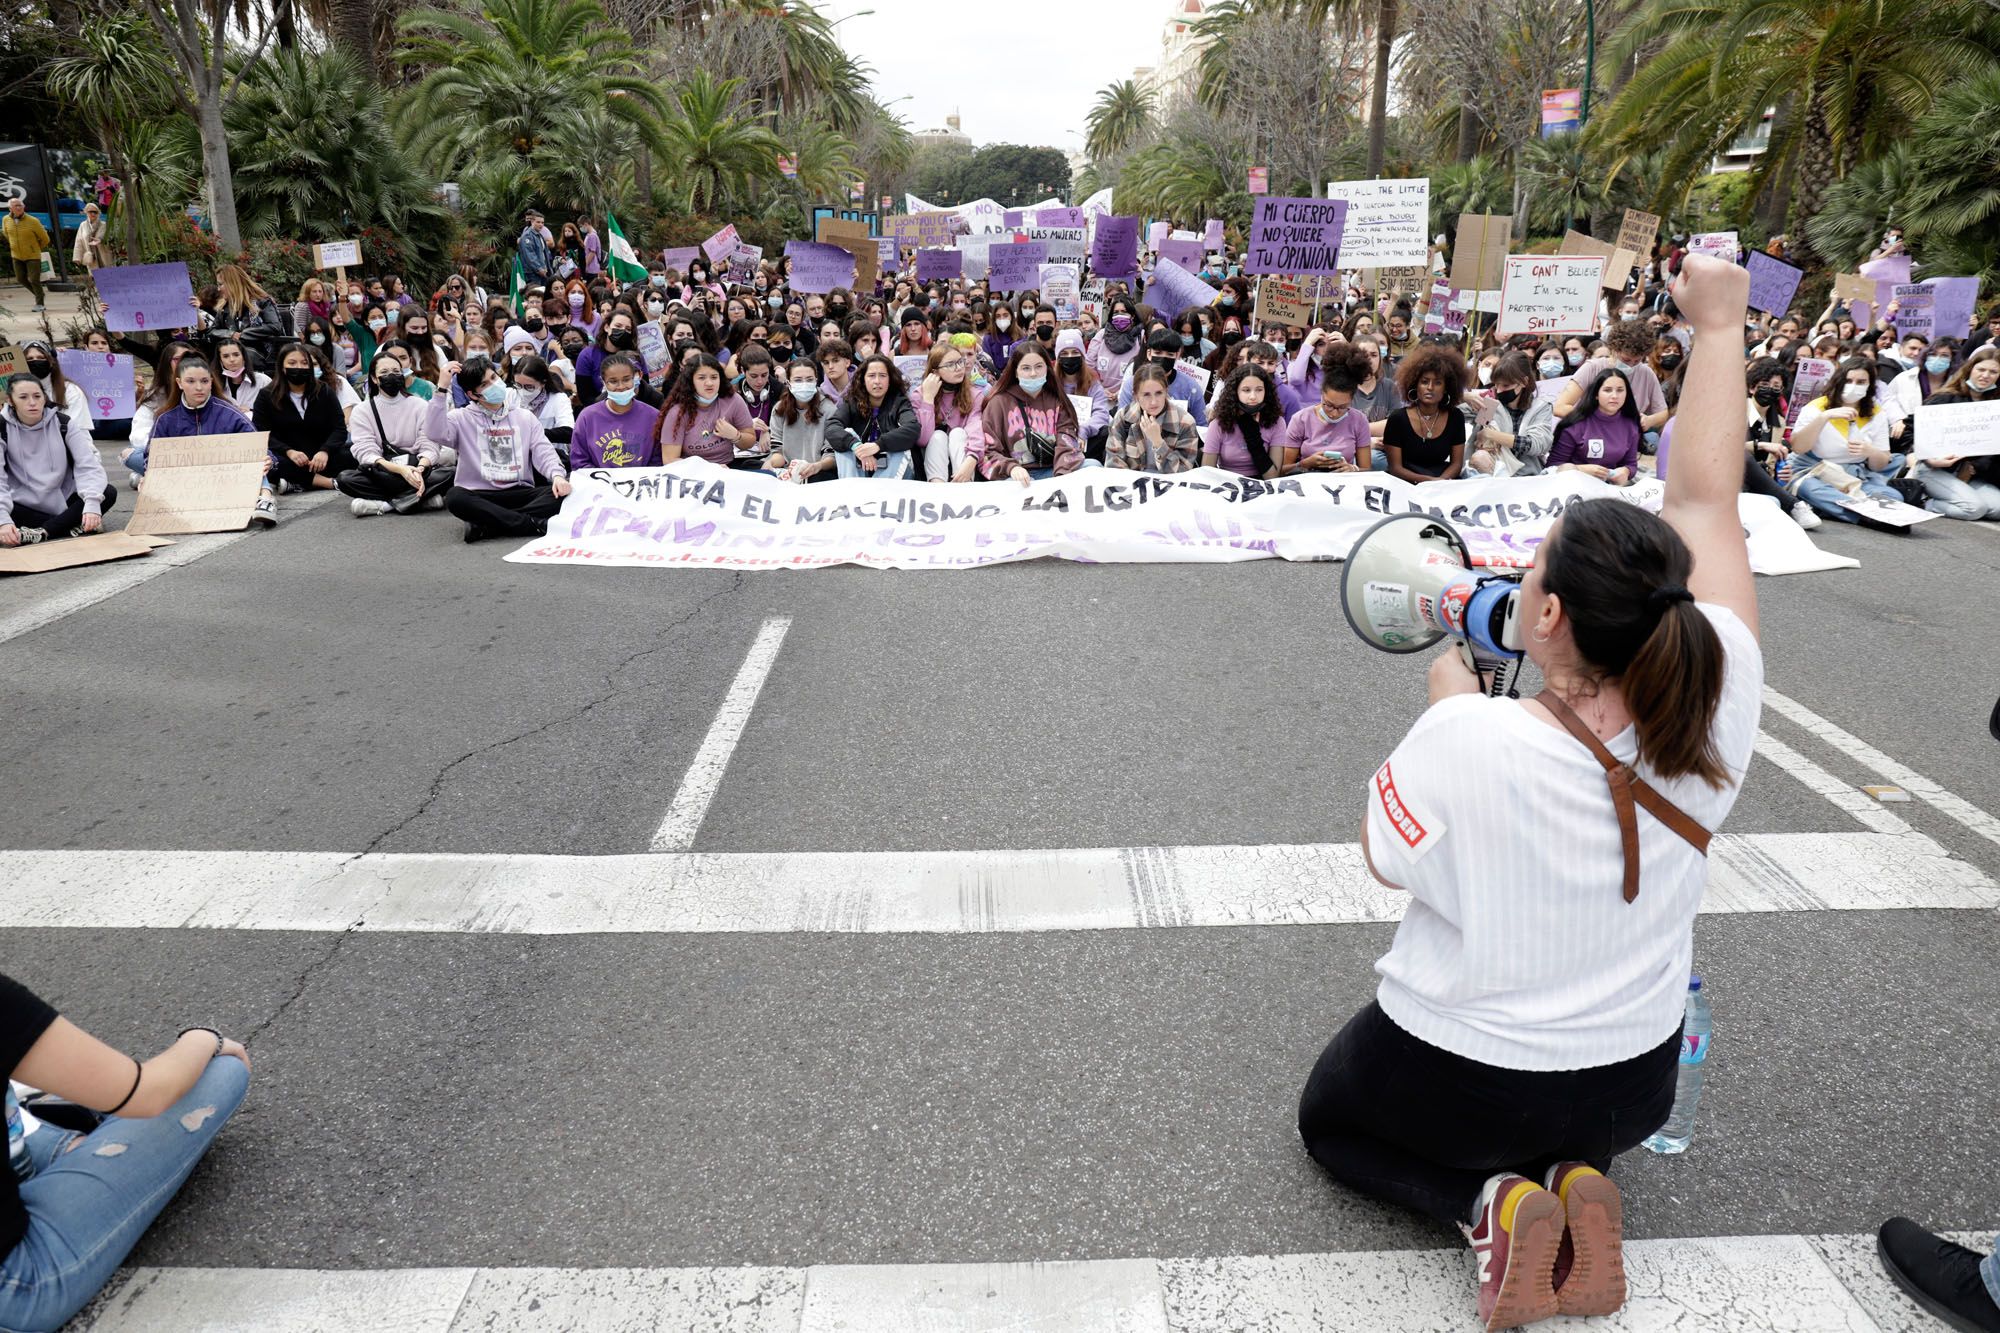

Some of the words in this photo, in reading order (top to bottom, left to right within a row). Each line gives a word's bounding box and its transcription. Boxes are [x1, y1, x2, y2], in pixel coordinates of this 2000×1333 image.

[1355, 186, 1373, 196] ALL
[1378, 185, 1392, 195] THE
[1399, 184, 1426, 195] LITTLE
[1400, 200, 1423, 208] RIGHT
[1263, 202, 1278, 222] MI
[1284, 203, 1336, 225] CUERPO
[1357, 215, 1384, 223] NEVER
[1389, 213, 1417, 222] DOUBT
[1031, 229, 1048, 240] LAS
[1050, 228, 1082, 242] MUJERES
[1262, 226, 1281, 242] NO
[1032, 246, 1042, 254] LA
[1278, 242, 1338, 271] OPINIÓN
[1532, 263, 1559, 278] CAN'T
[1567, 265, 1600, 277] BELIEVE
[1269, 281, 1279, 290] EL
[1532, 283, 1549, 295] I'M
[1555, 287, 1579, 296] STILL
[1266, 300, 1275, 308] ES
[1280, 303, 1289, 311] LA
[1508, 304, 1555, 313] PROTESTING
[1562, 304, 1584, 313] THIS
[595, 429, 623, 449] ROYAL
[687, 439, 725, 450] COLORA
[590, 470, 727, 510] CONTRA
[741, 494, 781, 525] EL
[1021, 488, 1070, 514] LA
[1322, 484, 1346, 505] Y
[1364, 485, 1395, 517] EL
[1384, 787, 1422, 842] ORDEN
